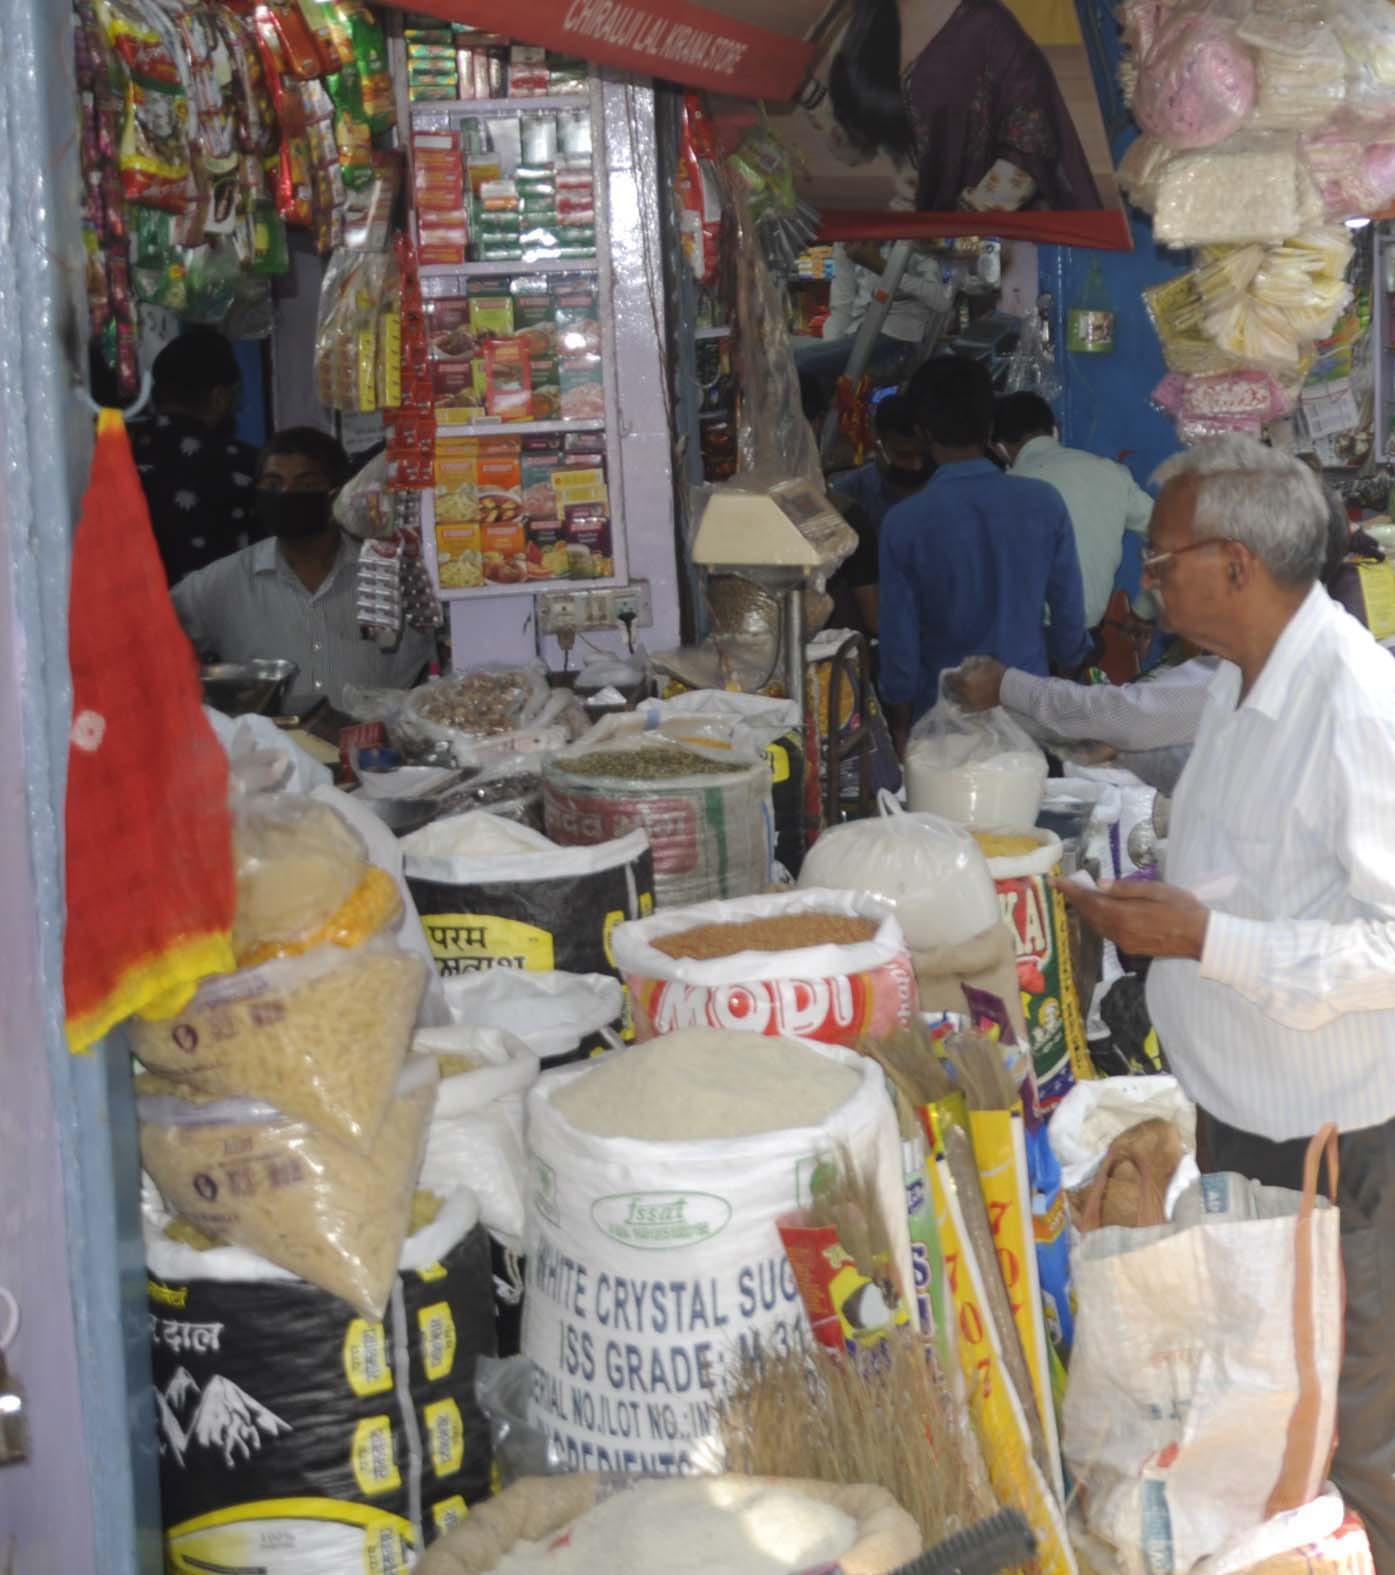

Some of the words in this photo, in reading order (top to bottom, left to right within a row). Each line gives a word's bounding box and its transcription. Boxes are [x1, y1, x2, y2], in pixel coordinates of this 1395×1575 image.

[703, 36, 748, 75] STORE
[427, 925, 487, 952] परम
[655, 974, 854, 1034] MODI
[535, 1244, 587, 1318] WHITE
[596, 1271, 729, 1333] CRYSTAL
[162, 1319, 225, 1352] दाल
[560, 1320, 595, 1383] ISS
